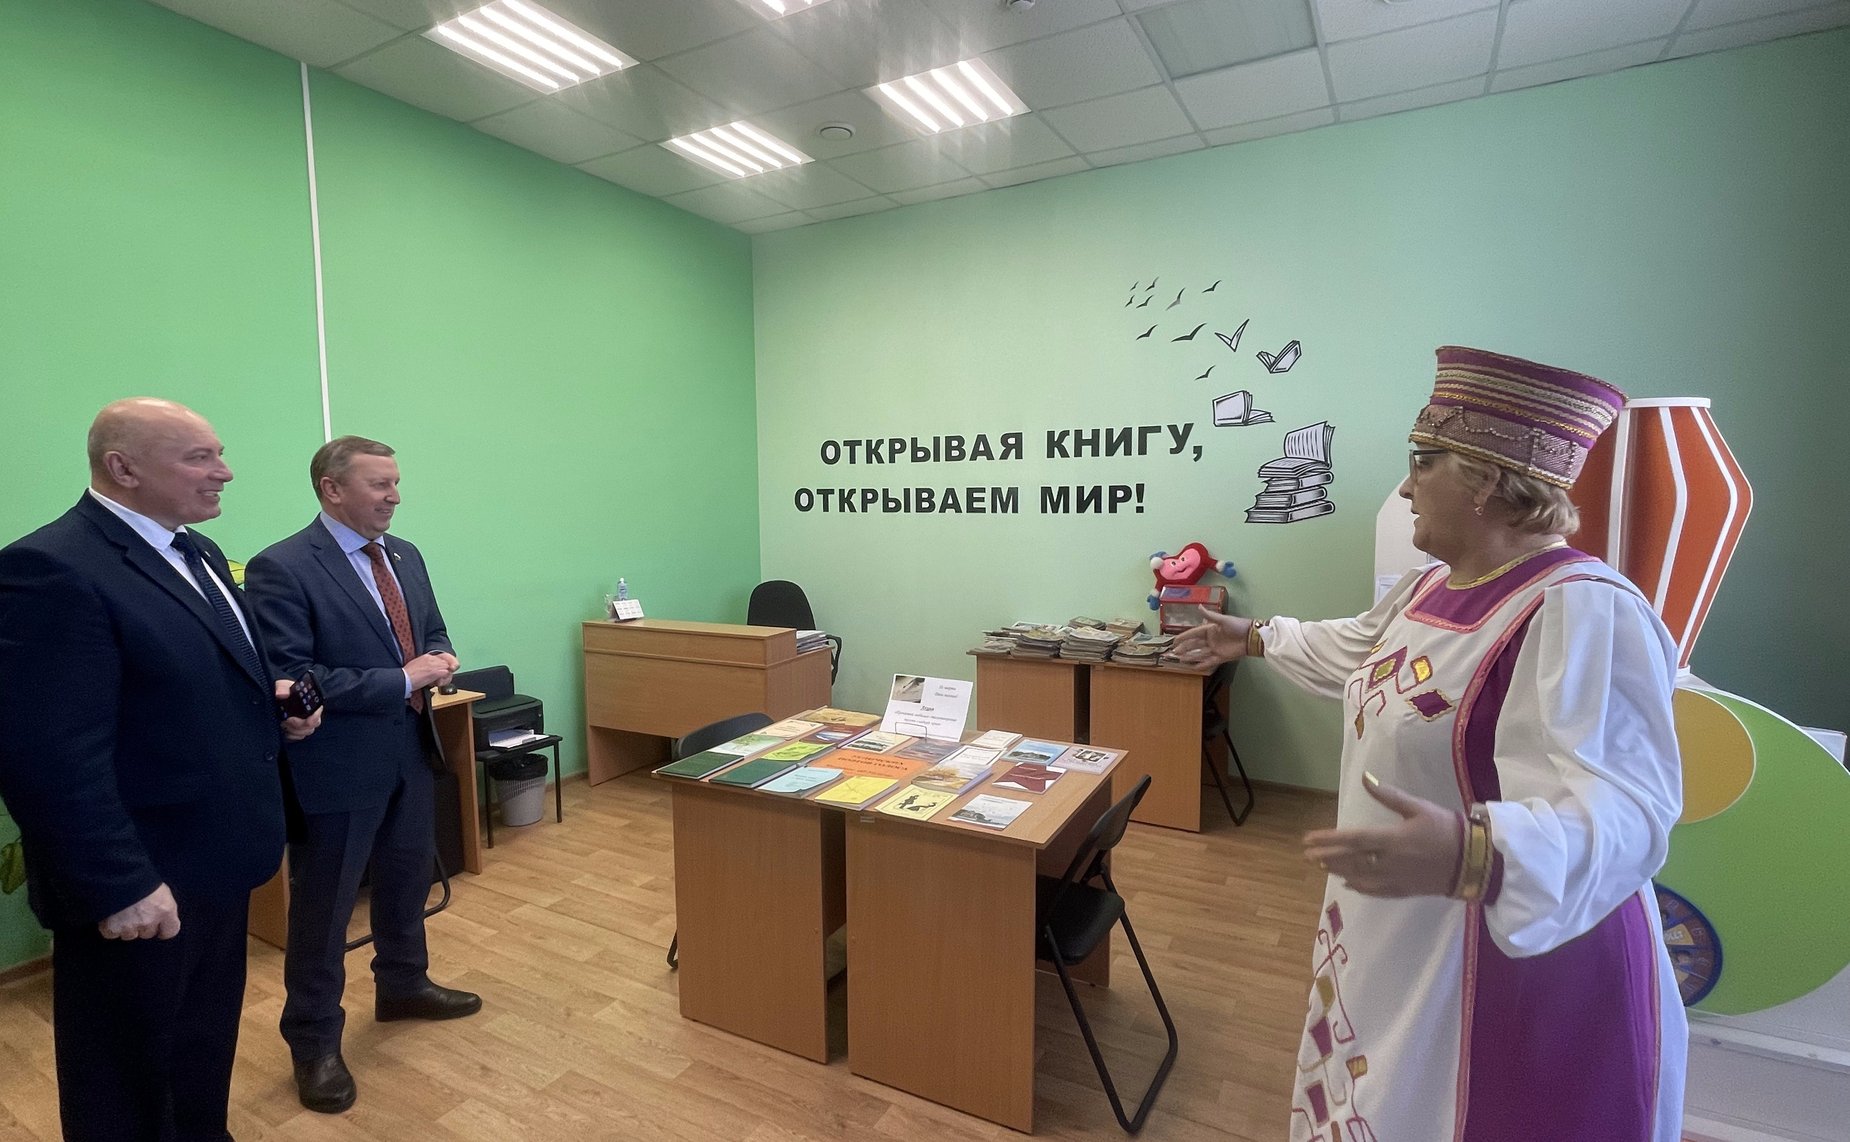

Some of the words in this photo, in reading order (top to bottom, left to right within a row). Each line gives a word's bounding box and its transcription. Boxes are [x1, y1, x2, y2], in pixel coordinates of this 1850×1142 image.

[820, 431, 1024, 465] ОТКРЫВАЯ
[1046, 422, 1203, 462] КНИГУ,
[794, 486, 1019, 514] ОТКРЫВАЕМ
[1040, 483, 1145, 514] МИР!
